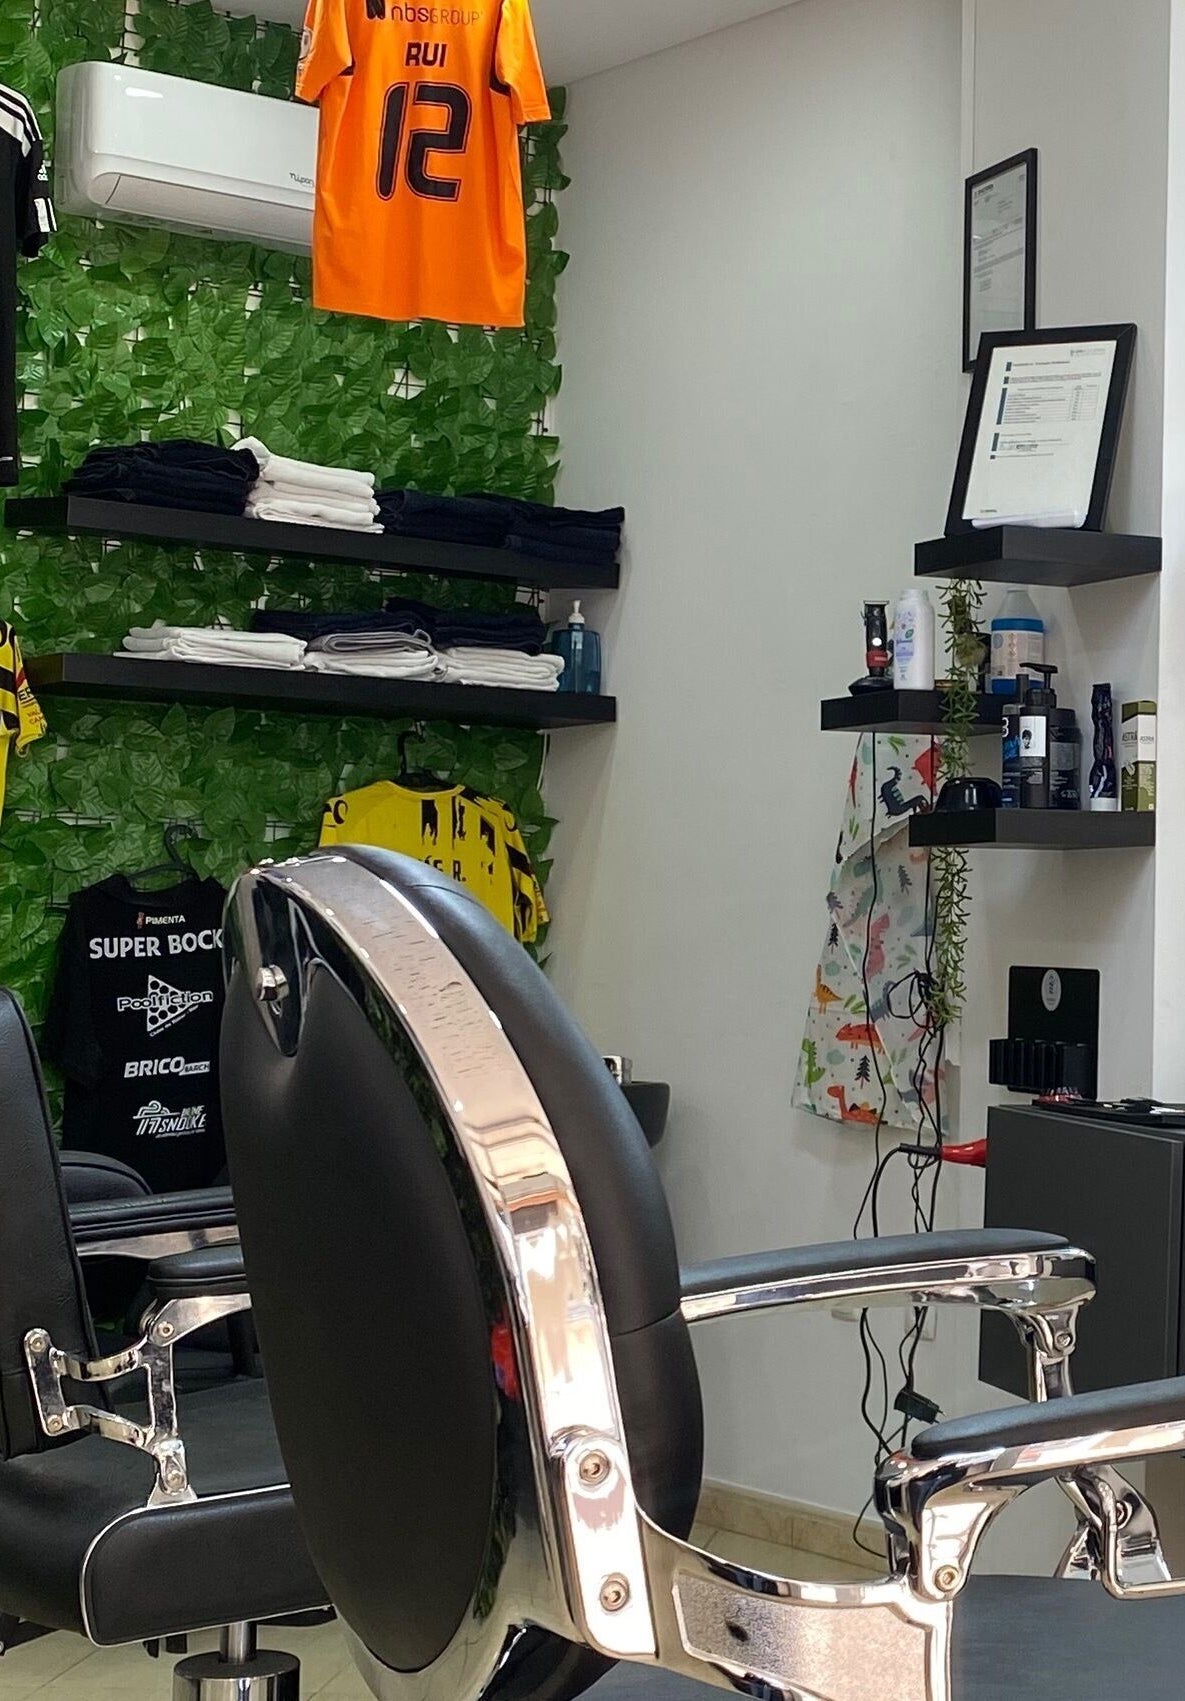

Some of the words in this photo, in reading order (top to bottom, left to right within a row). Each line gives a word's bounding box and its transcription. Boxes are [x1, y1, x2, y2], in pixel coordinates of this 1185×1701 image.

[404, 42, 448, 67] RUI
[376, 81, 472, 202] 12
[145, 914, 187, 925] PIMENTA
[89, 936, 162, 959] SUPER
[167, 928, 223, 954] BOCK
[124, 1056, 185, 1078] BRICO
